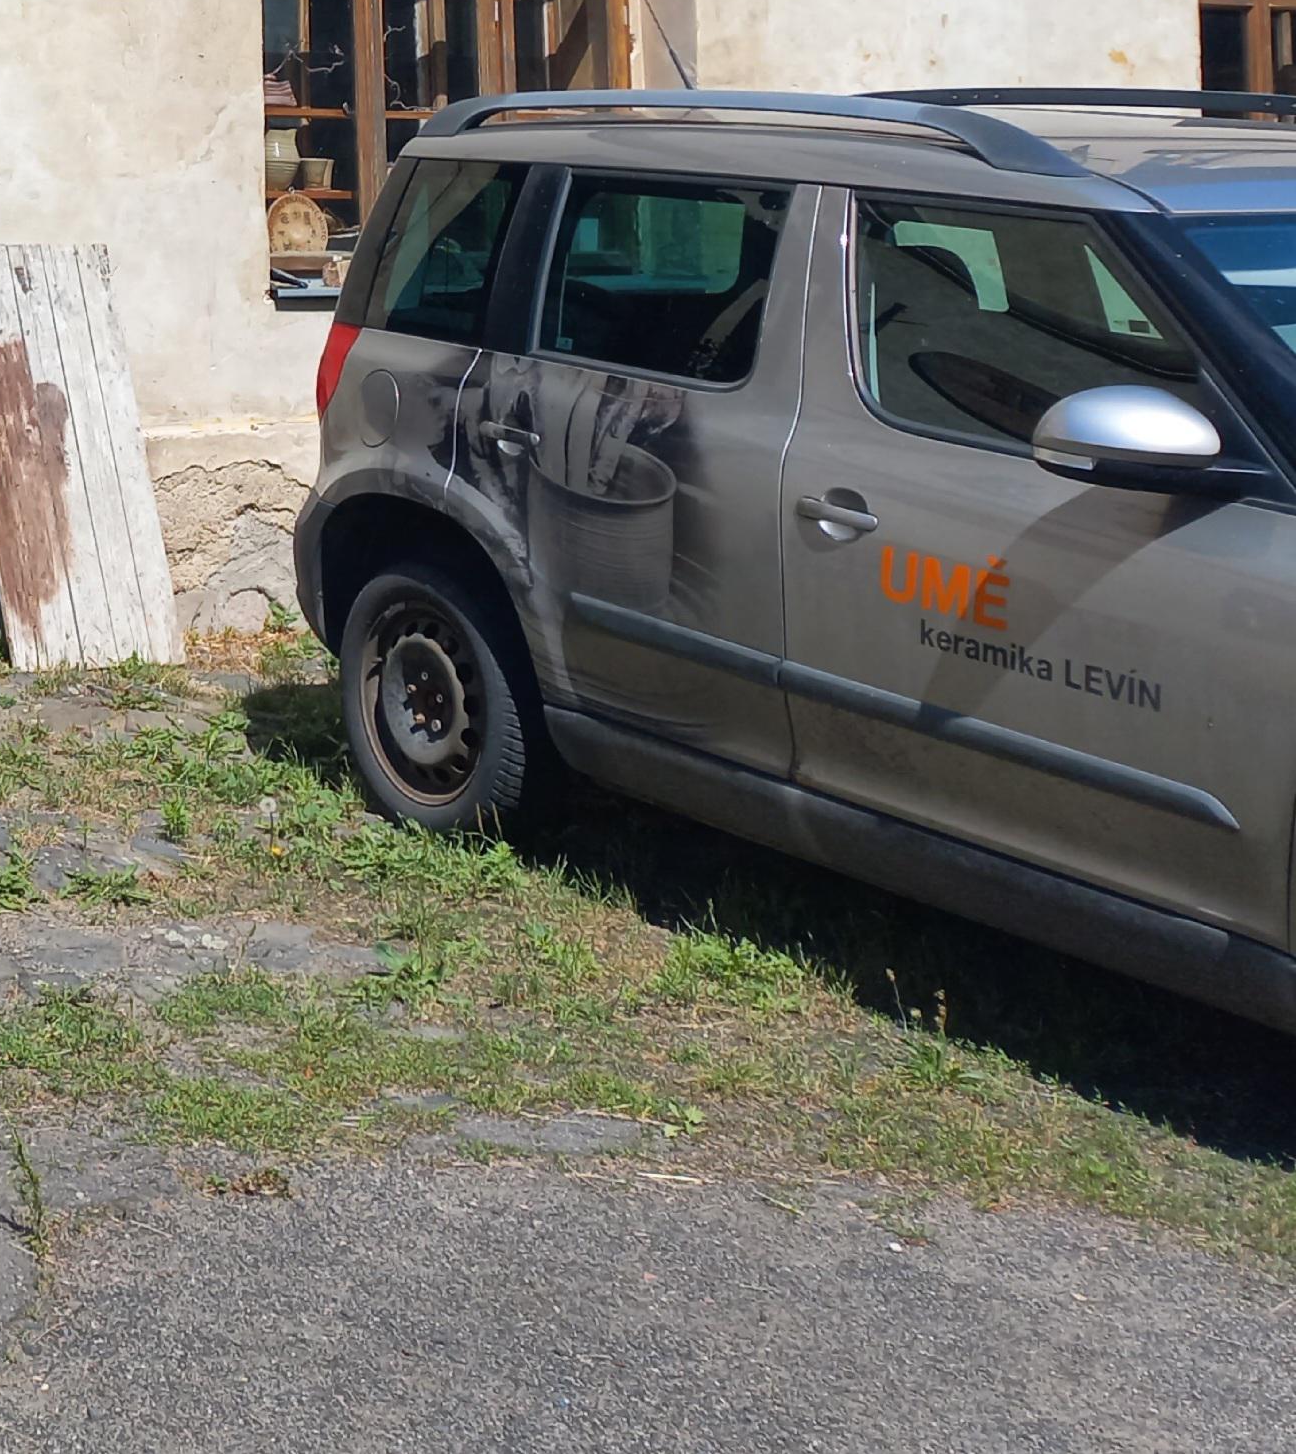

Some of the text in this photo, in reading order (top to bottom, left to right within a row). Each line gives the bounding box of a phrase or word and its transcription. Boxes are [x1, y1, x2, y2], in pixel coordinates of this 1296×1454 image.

[879, 544, 1010, 631] UMĚ
[920, 619, 1162, 712] keramika LEVÍN
